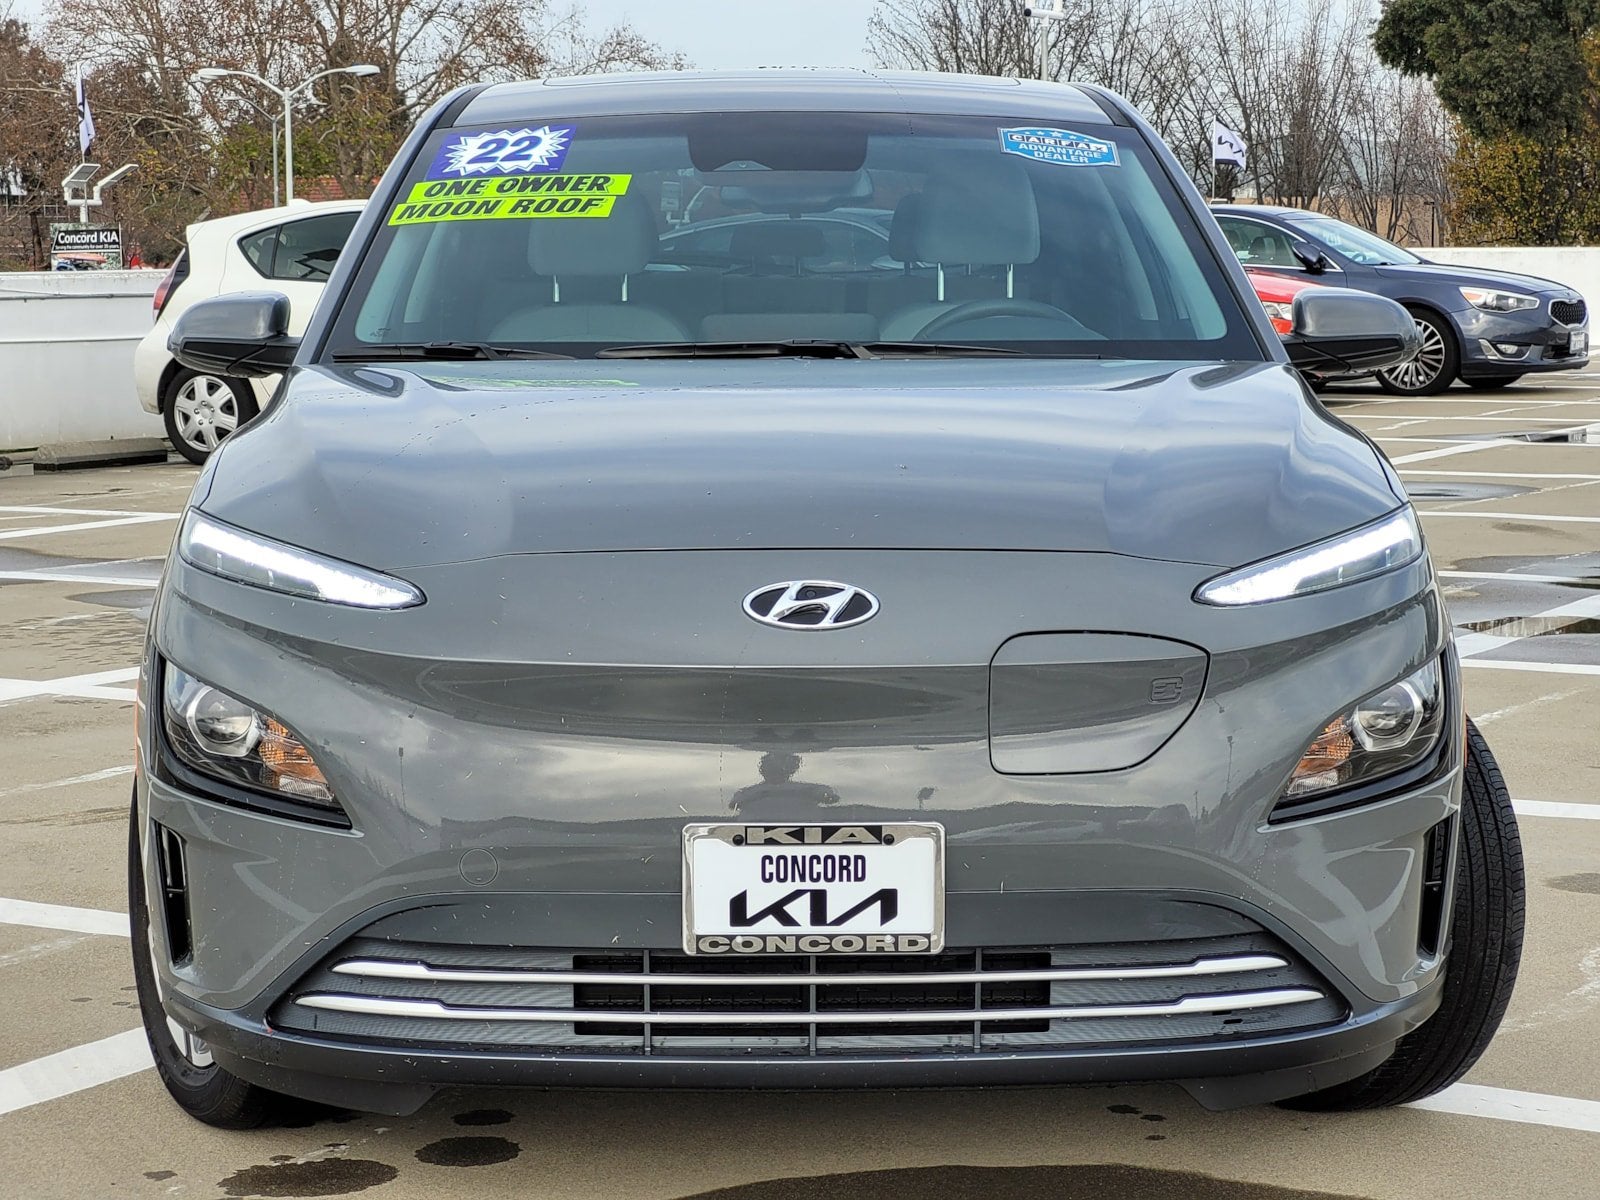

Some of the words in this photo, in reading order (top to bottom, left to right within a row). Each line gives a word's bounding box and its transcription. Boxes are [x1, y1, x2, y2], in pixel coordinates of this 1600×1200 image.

[465, 135, 542, 165] 22
[1009, 133, 1108, 153] CARFAX
[1019, 143, 1102, 159] ADVANTAGE
[1034, 151, 1089, 163] DEALER
[423, 178, 488, 199] ONE
[496, 175, 614, 195] OWNER
[396, 199, 501, 221] MOON
[507, 198, 602, 216] ROOF
[58, 232, 97, 243] Concord
[99, 231, 118, 242] KIA
[746, 827, 882, 844] KIA
[761, 854, 866, 883] CONCORD
[698, 935, 930, 953] CONCORD
